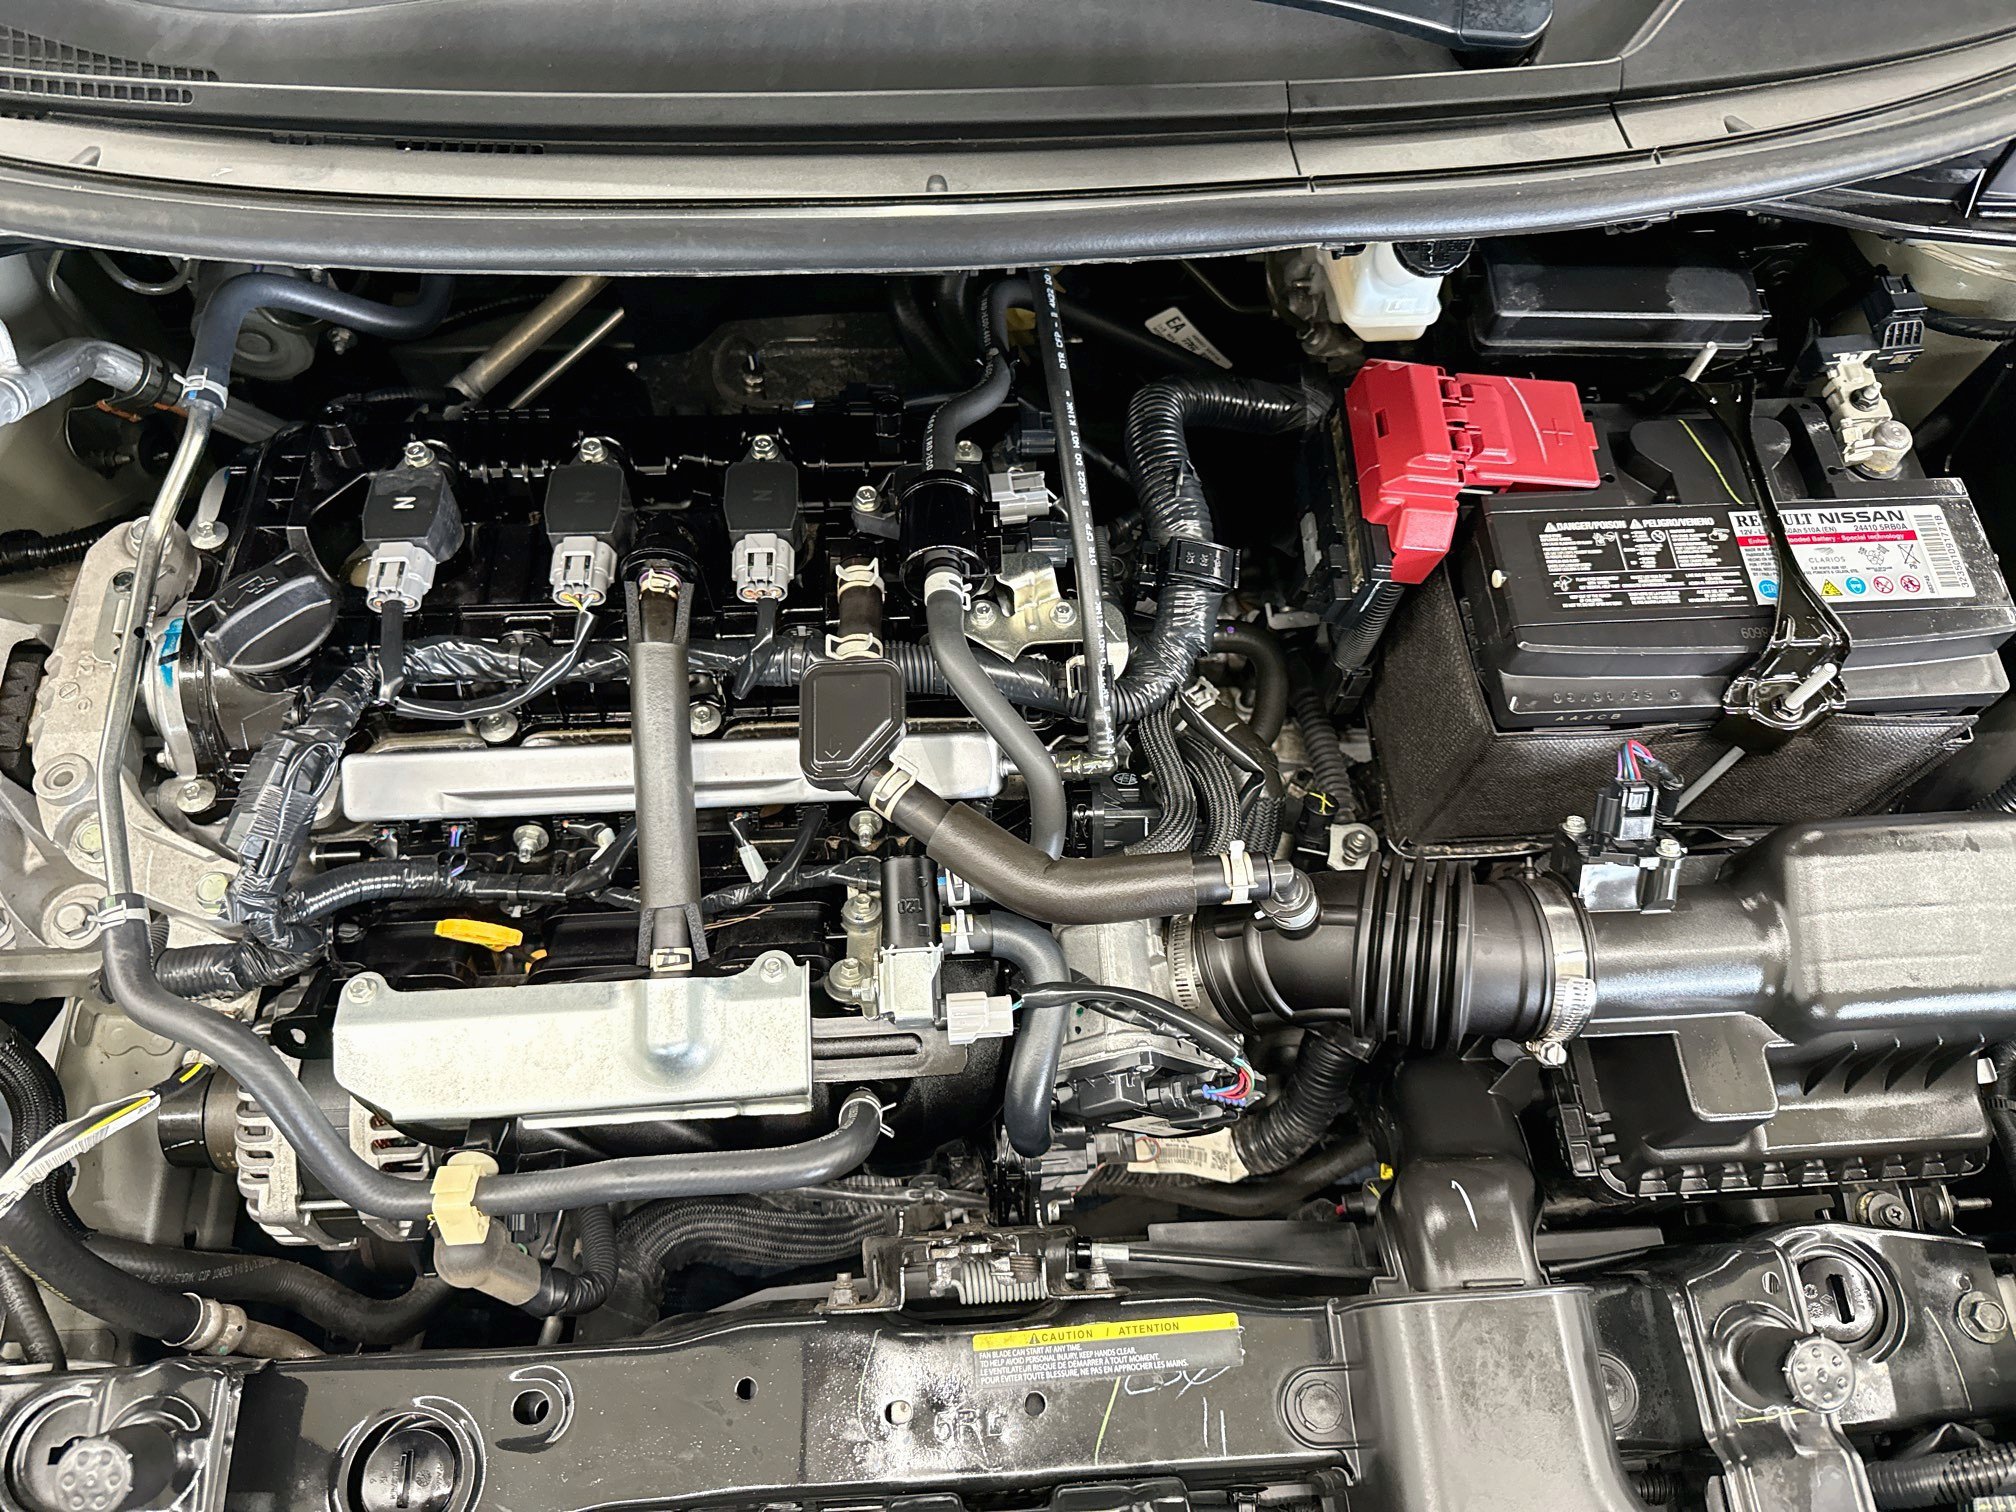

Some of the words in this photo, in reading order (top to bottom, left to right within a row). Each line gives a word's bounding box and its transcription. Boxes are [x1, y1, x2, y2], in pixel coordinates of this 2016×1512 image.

[1166, 316, 1186, 334] EA
[1054, 331, 1064, 348] CFP
[1057, 352, 1067, 370] DTR
[1066, 402, 1076, 426] KINK
[1070, 430, 1080, 448] NOT
[1074, 453, 1084, 466] DO
[1078, 471, 1087, 495] 4X22
[1556, 520, 1628, 530] DANGER/POISON
[1642, 517, 1715, 528] PELIGRO/VENENO
[1734, 512, 1813, 528] REULT
[1818, 510, 1904, 524] NISSAN
[1854, 524, 1876, 532] 24410
[1085, 522, 1094, 542] CFP
[1867, 532, 1904, 540] technology
[1088, 546, 1097, 566] DTR
[1042, 1329, 1093, 1341] CAUTION
[1118, 1322, 1180, 1335] ATTENTION
[980, 1352, 992, 1360] FAN
[992, 1349, 1012, 1358] BLADE
[1012, 1349, 1025, 1357] CAN
[1026, 1347, 1044, 1356] START
[1053, 1345, 1066, 1353] ANY
[980, 1360, 989, 1368] TO
[989, 1358, 1004, 1366] HELP
[1005, 1357, 1025, 1366] AVOID
[1026, 1354, 1056, 1364] PERSONAL
[1079, 1350, 1094, 1358] KEEP
[1094, 1348, 1116, 1357] HANDS
[980, 1376, 1000, 1385] POUR
[1023, 1372, 1045, 1381] TOUTE
[1080, 1367, 1090, 1376] NE
[1090, 1366, 1103, 1375] PAS
[1104, 1365, 1113, 1373] EN
[1113, 1361, 1154, 1373] APPROCHER
[1154, 1360, 1165, 1368] LES
[981, 1368, 989, 1376] LE
[989, 1364, 1032, 1376] VENTILATEUR
[1032, 1362, 1057, 1372] RISQUE
[1057, 1361, 1066, 1369] DE
[1110, 1355, 1128, 1364] TOUT
[1128, 1353, 1160, 1363] MOMENT.
